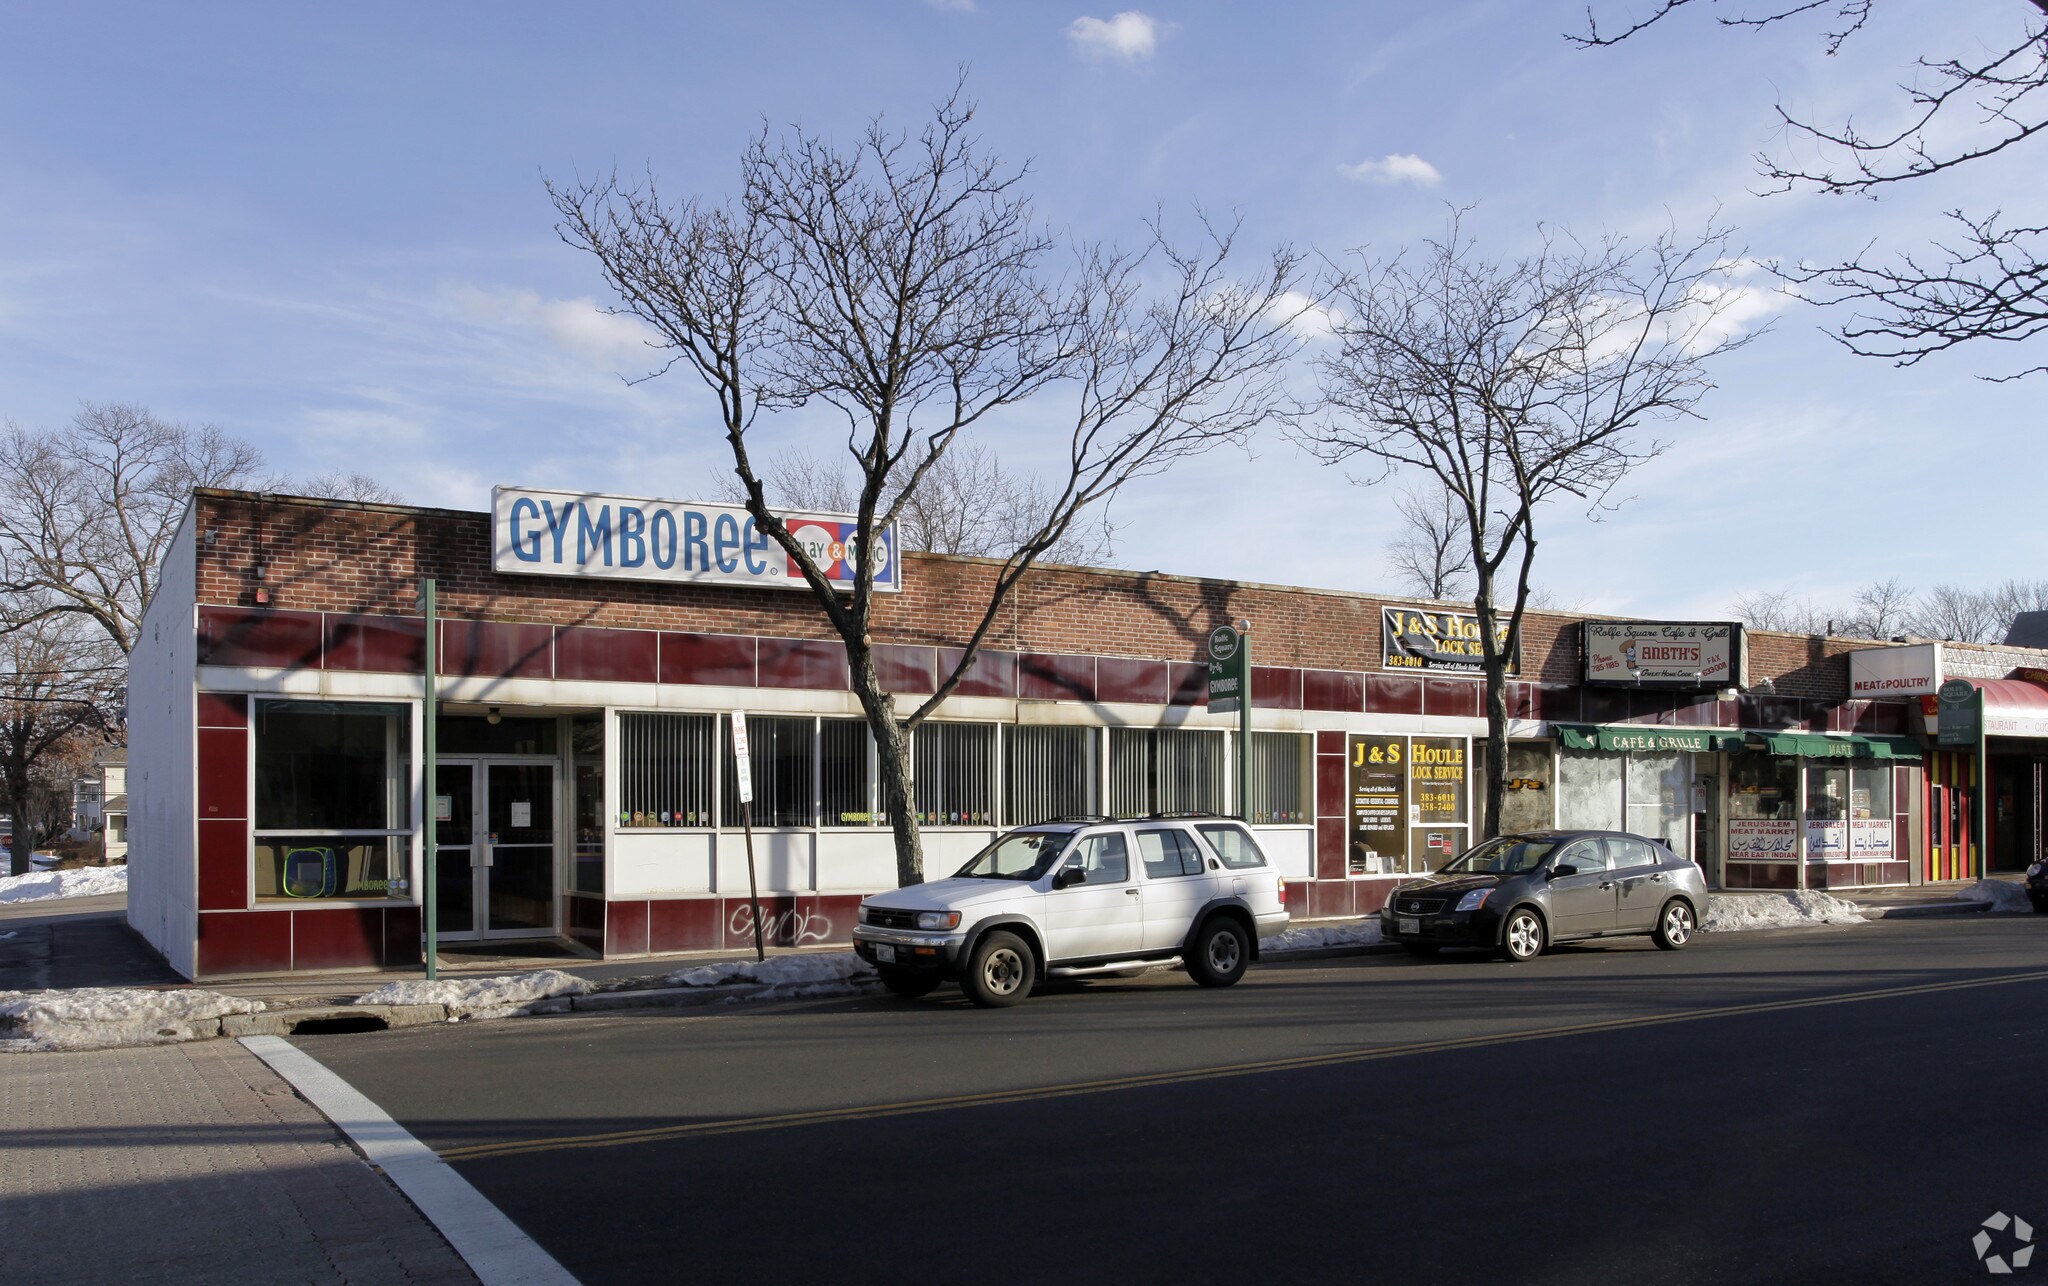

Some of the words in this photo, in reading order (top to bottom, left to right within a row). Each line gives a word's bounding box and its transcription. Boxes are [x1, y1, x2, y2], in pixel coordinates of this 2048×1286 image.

[797, 541, 824, 558] aY
[832, 543, 843, 559] &
[848, 544, 884, 562] MiC
[1393, 612, 1404, 636] J
[1408, 616, 1422, 634] &
[1426, 615, 1438, 635] S
[1591, 626, 1622, 640] Rolfe
[1624, 626, 1658, 639] Square
[1661, 626, 1686, 640] Cafe
[1688, 627, 1696, 637] &
[1701, 627, 1728, 641] Grill
[1214, 643, 1233, 653] Square
[1435, 640, 1465, 655] LOCK
[1389, 655, 1422, 667] 383-6010
[1592, 654, 1613, 664] Phone
[1706, 654, 1721, 664] FAX
[1428, 661, 1444, 670] Serving
[1613, 735, 1645, 749] CAFÉ
[1647, 737, 1655, 748] &
[1660, 737, 1701, 749] GRILLE
[1353, 743, 1365, 767] J
[1368, 746, 1384, 764] &
[1387, 744, 1400, 764] S
[1411, 744, 1463, 765] HOULE
[1411, 766, 1432, 779] LOCK
[1434, 766, 1463, 779] SERVICE
[1420, 793, 1456, 802] 383-6010
[1420, 803, 1456, 812] 258-7400
[1808, 821, 1845, 829] JERUSALEM
[1852, 821, 1867, 829] MEAT
[1868, 821, 1890, 829] MARKET
